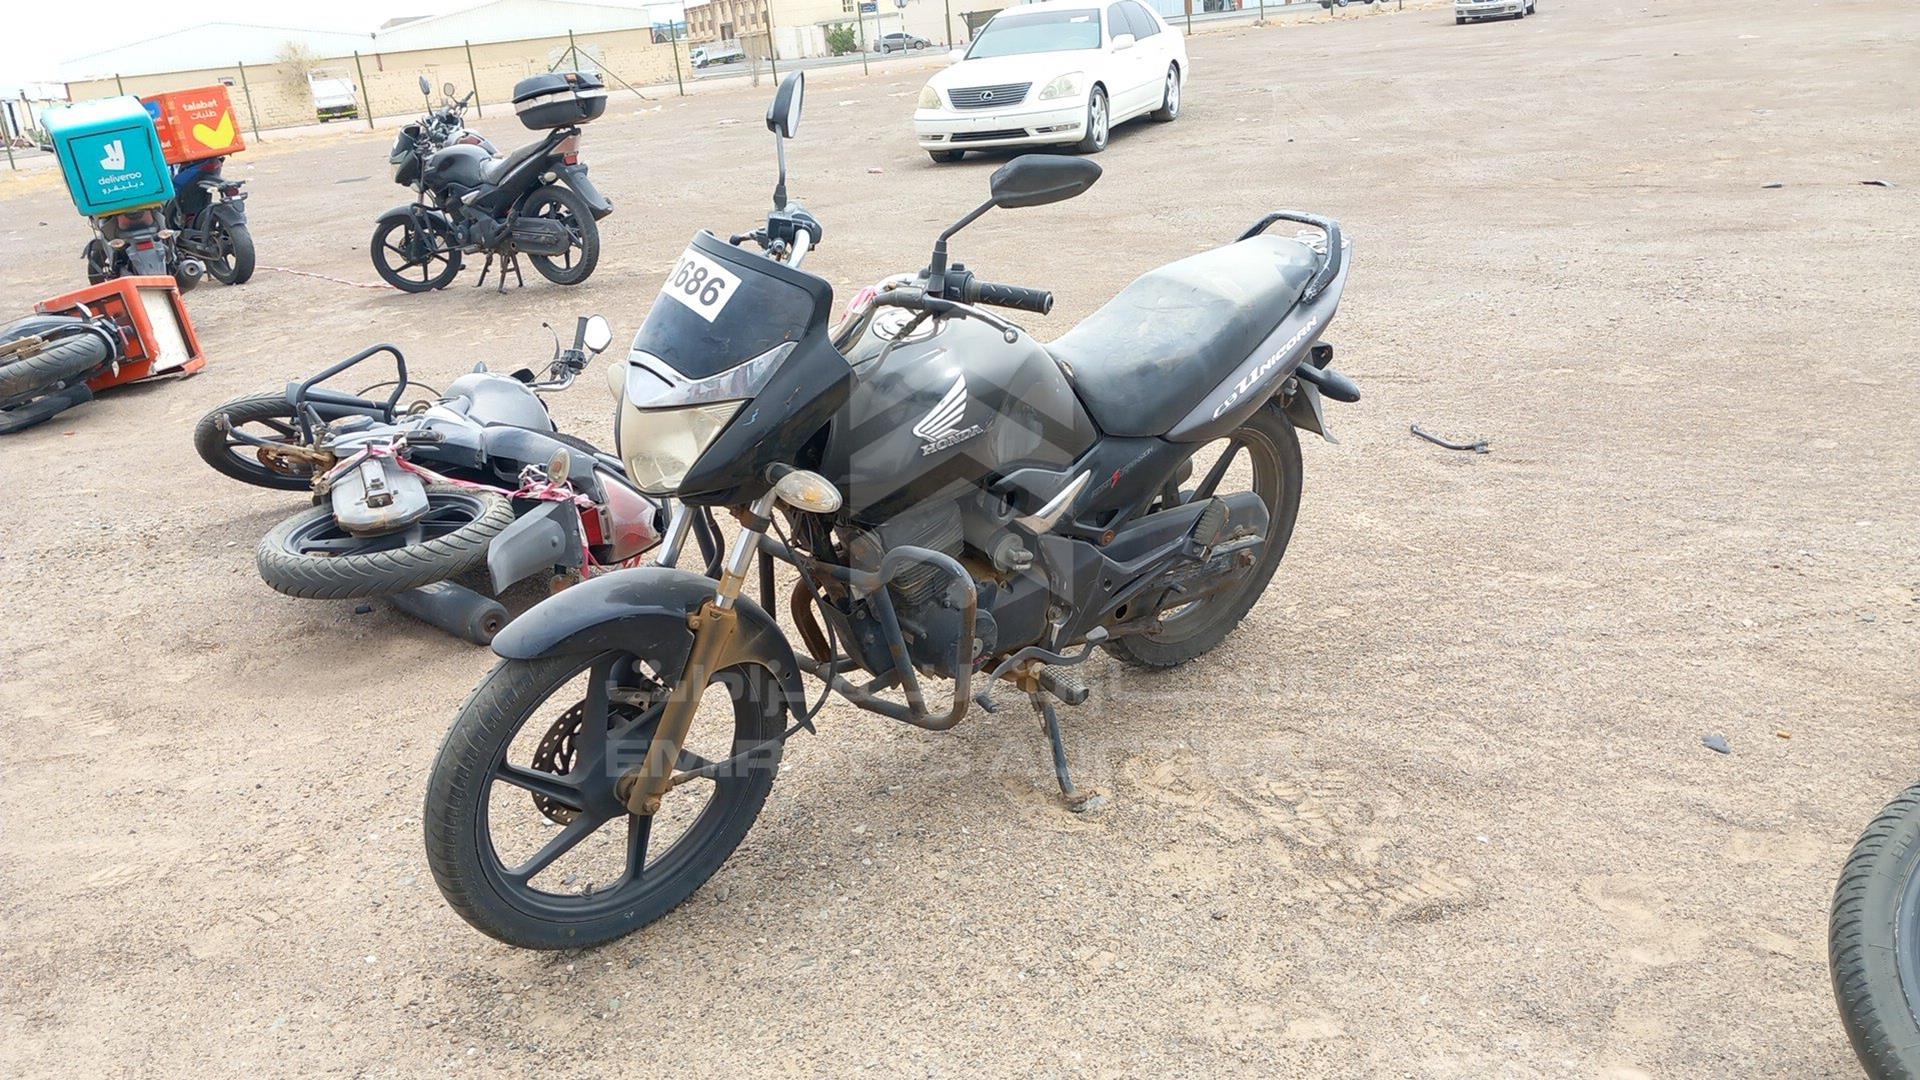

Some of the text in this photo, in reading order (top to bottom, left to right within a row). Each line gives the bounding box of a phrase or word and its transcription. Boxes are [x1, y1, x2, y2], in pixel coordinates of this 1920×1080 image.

[182, 98, 218, 111] talabat
[98, 171, 142, 185] deliveroo
[920, 424, 984, 457] HONDA
